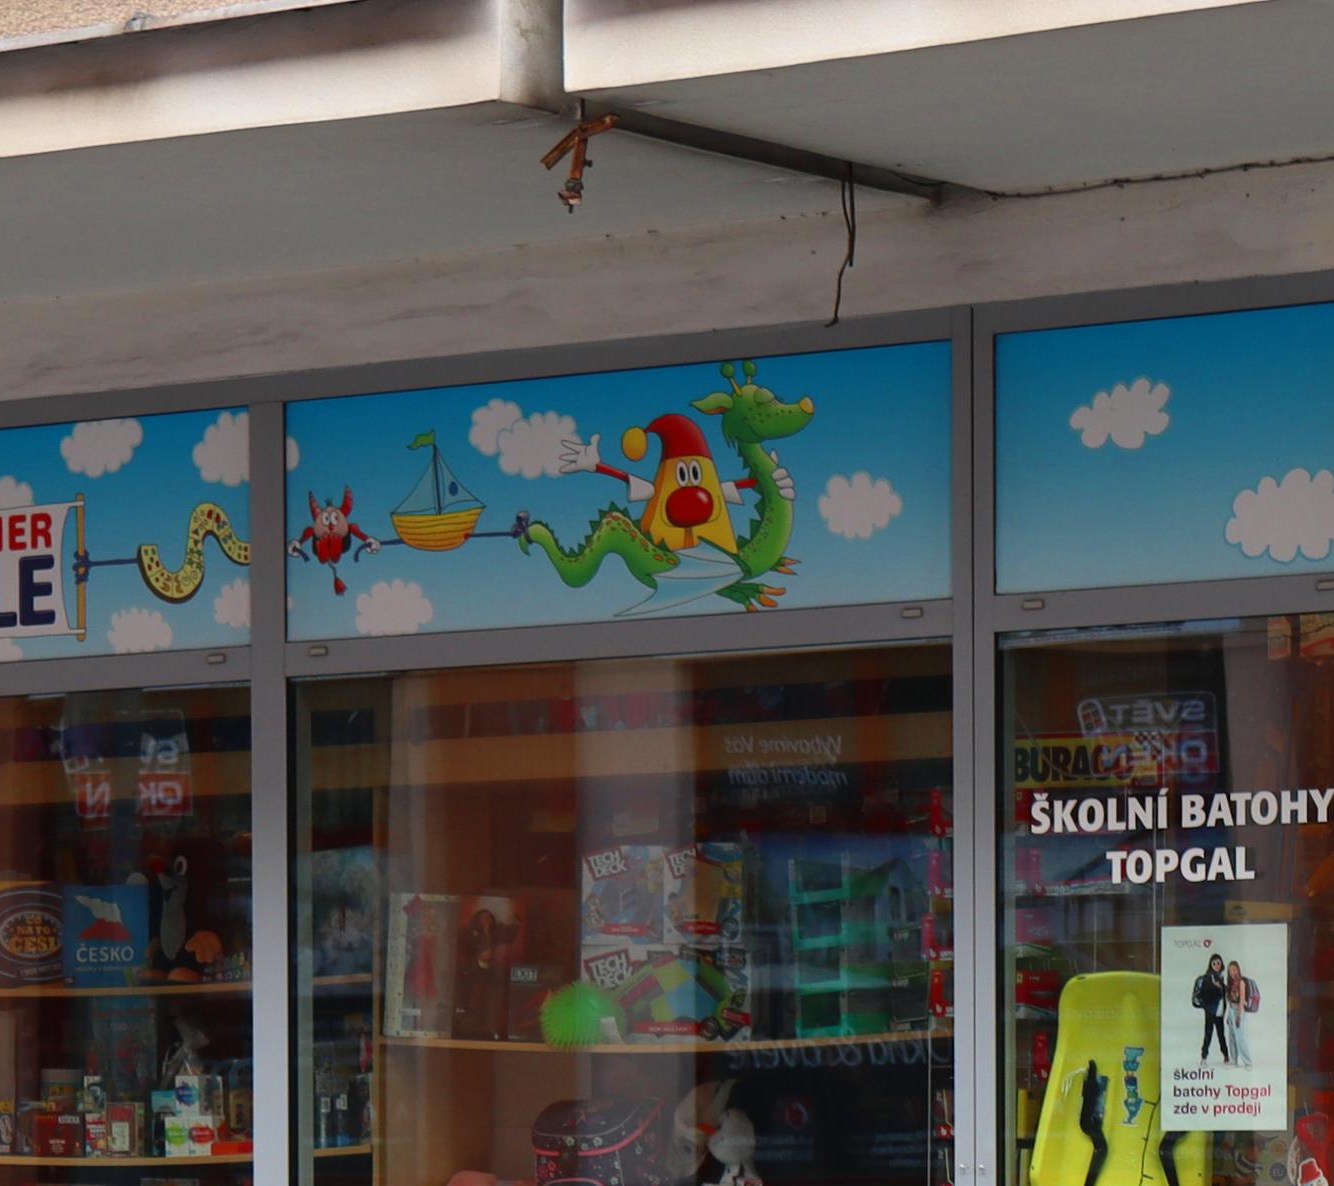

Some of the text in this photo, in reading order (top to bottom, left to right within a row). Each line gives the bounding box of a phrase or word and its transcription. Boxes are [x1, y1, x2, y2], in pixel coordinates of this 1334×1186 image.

[1030, 787, 1170, 835] ŠKOLNÍ
[589, 850, 621, 868] TECH
[1105, 845, 1256, 885] TOPGAL
[594, 861, 629, 877] DECK
[75, 943, 136, 964] ČESKO
[589, 952, 628, 973] TECH
[596, 966, 634, 988] DECK
[1173, 1067, 1215, 1082] školní
[1173, 1084, 1272, 1101] batohy Topgal
[1173, 1102, 1262, 1117] zde v prodeji
